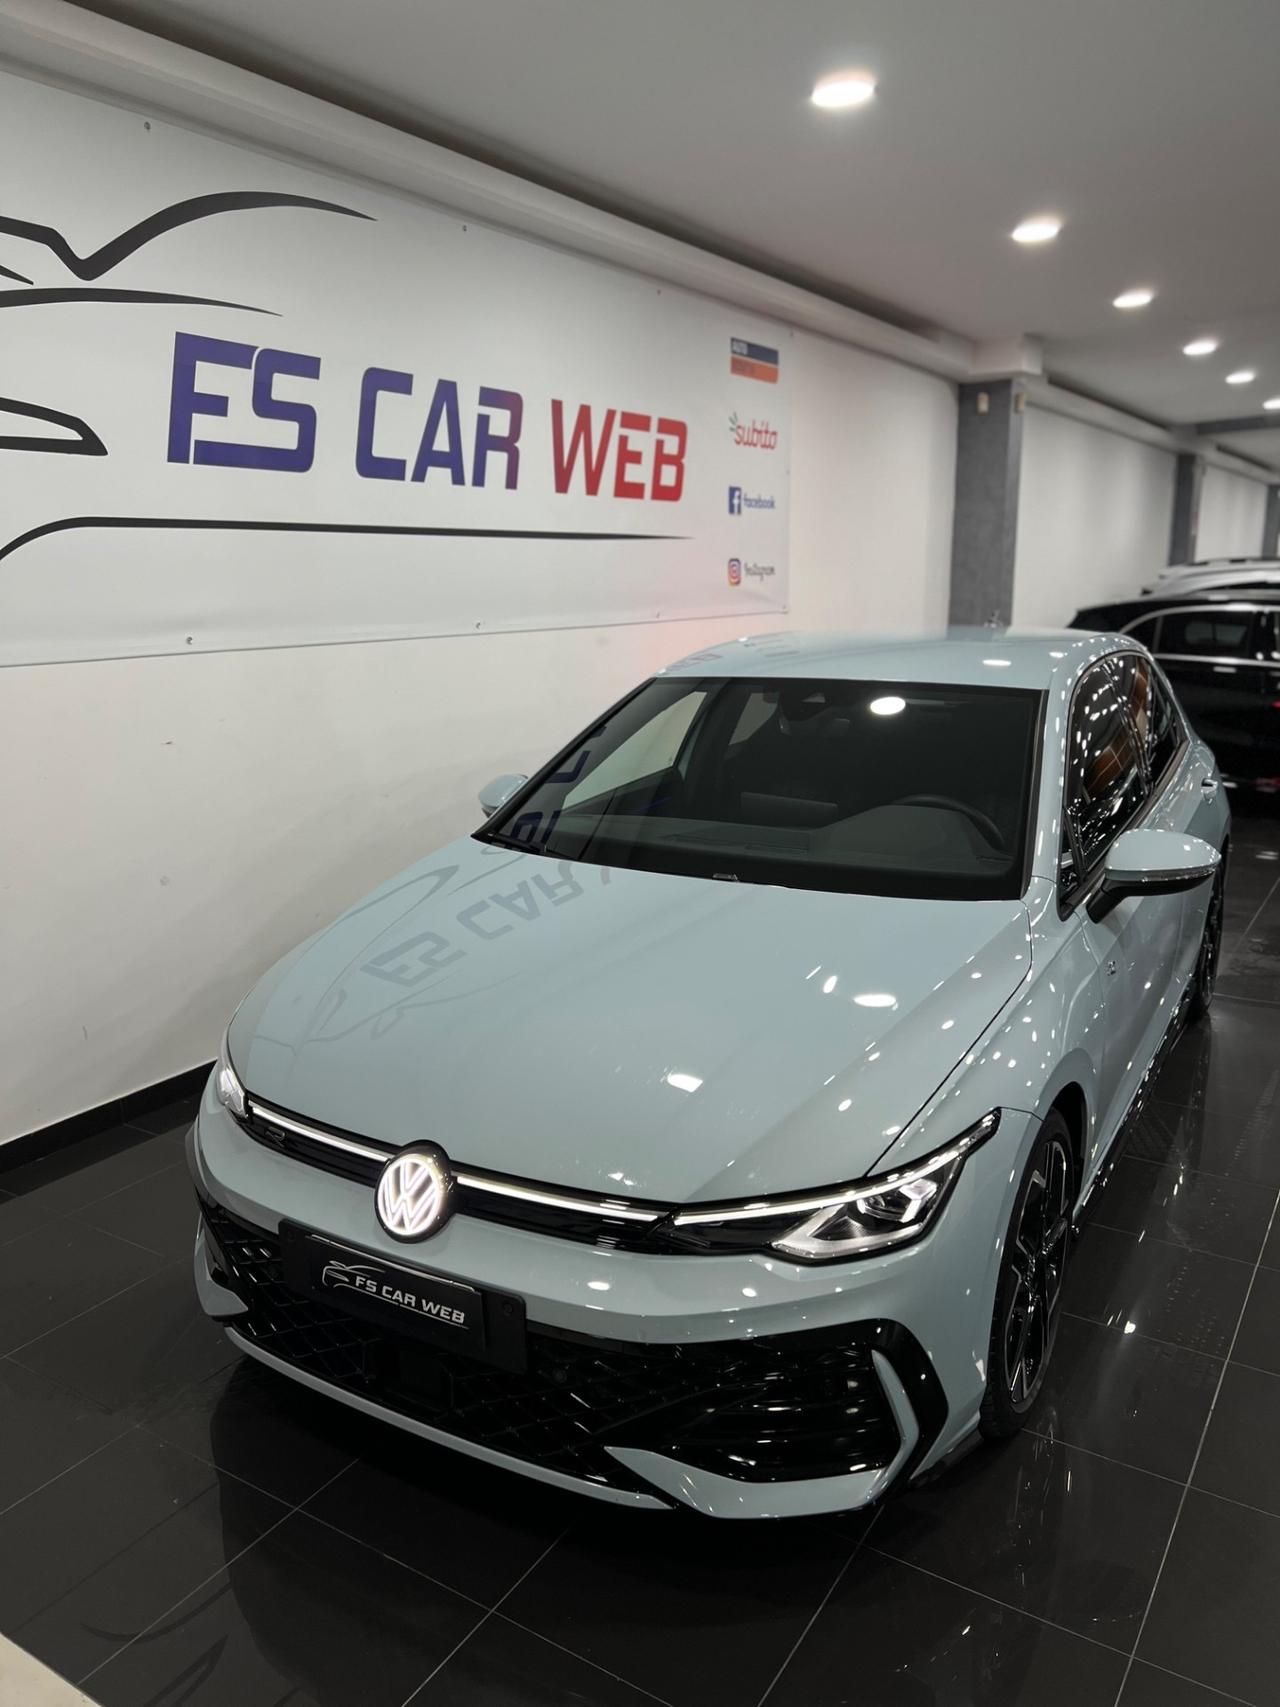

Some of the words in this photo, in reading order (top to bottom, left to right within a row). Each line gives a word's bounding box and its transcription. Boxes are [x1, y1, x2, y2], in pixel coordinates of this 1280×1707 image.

[167, 331, 321, 473] FS
[356, 367, 523, 490] CAR
[551, 398, 688, 503] WEB
[735, 418, 778, 450] subito
[355, 1275, 378, 1293] FS
[381, 1285, 416, 1307] CAR
[421, 1299, 465, 1324] WEB
